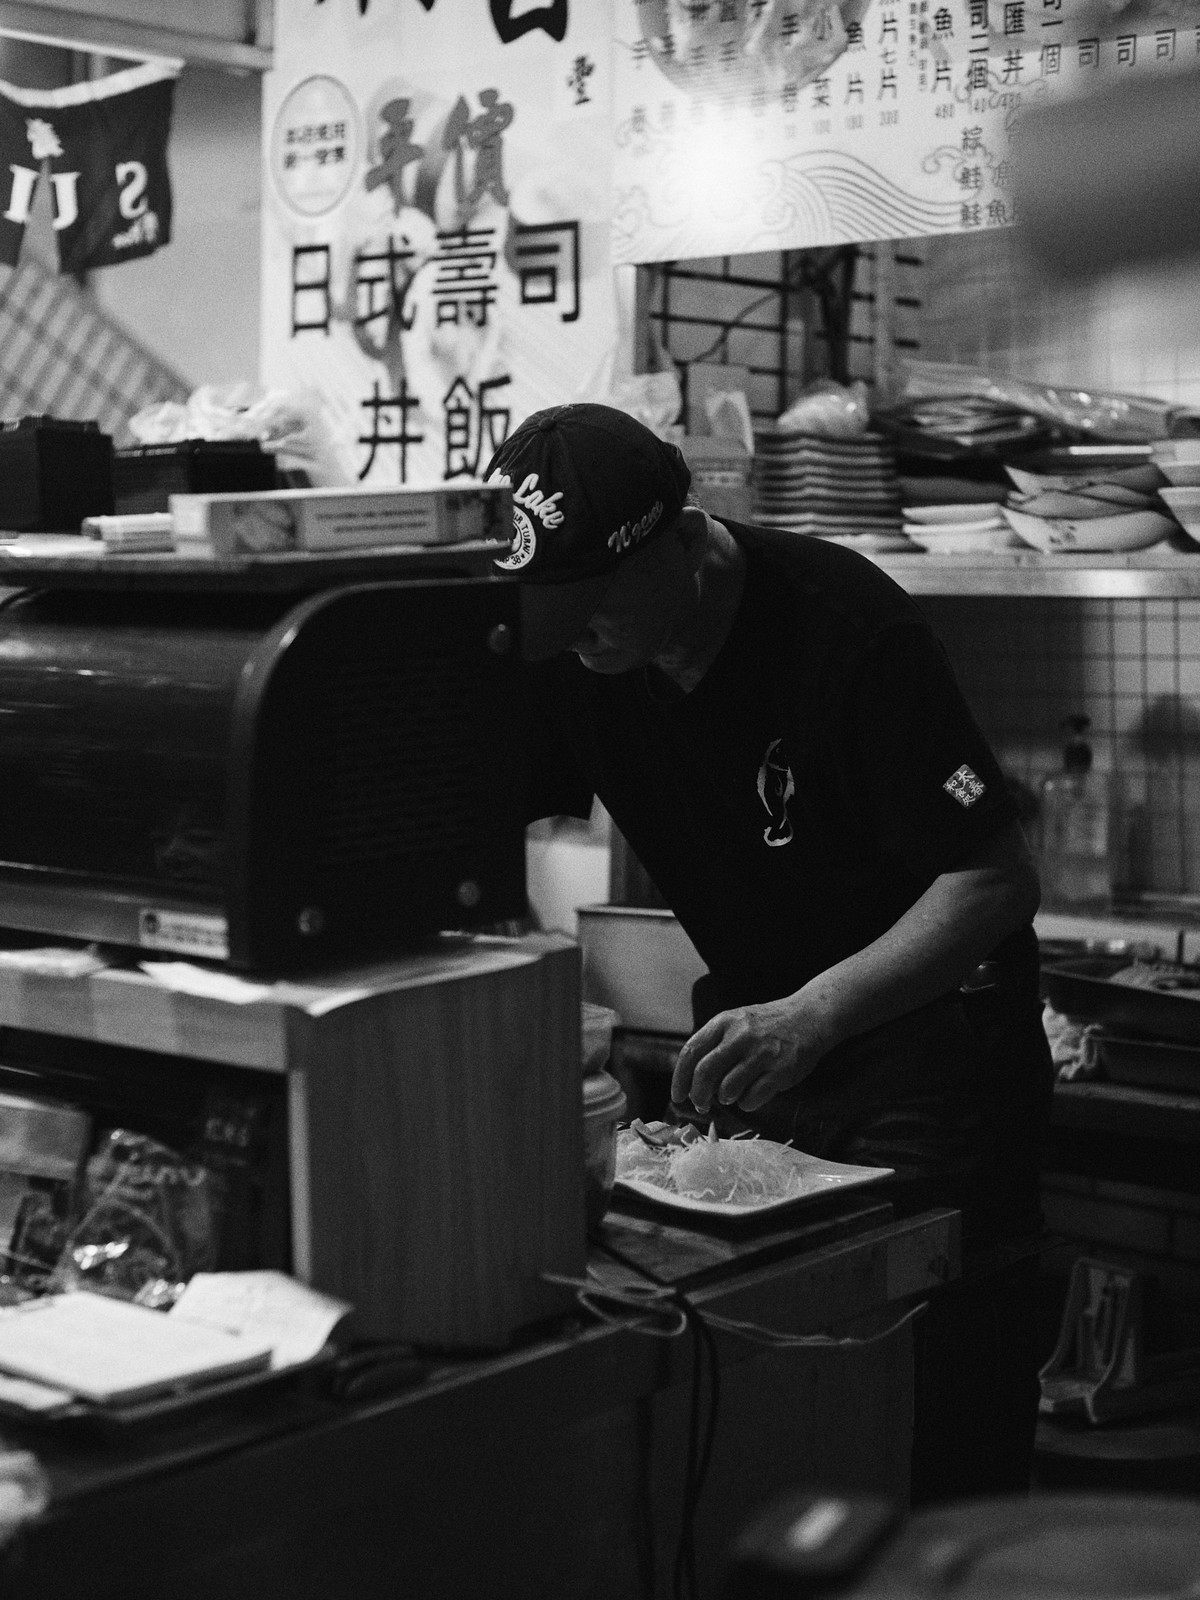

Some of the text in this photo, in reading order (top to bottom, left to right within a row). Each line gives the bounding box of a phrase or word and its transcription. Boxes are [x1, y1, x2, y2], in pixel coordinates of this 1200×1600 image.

[878, 0, 898, 101] 片七片
[1116, 34, 1138, 68] 司
[290, 220, 581, 339] 日式壽司
[357, 374, 512, 484] 丼飯
[512, 472, 566, 529] Lake
